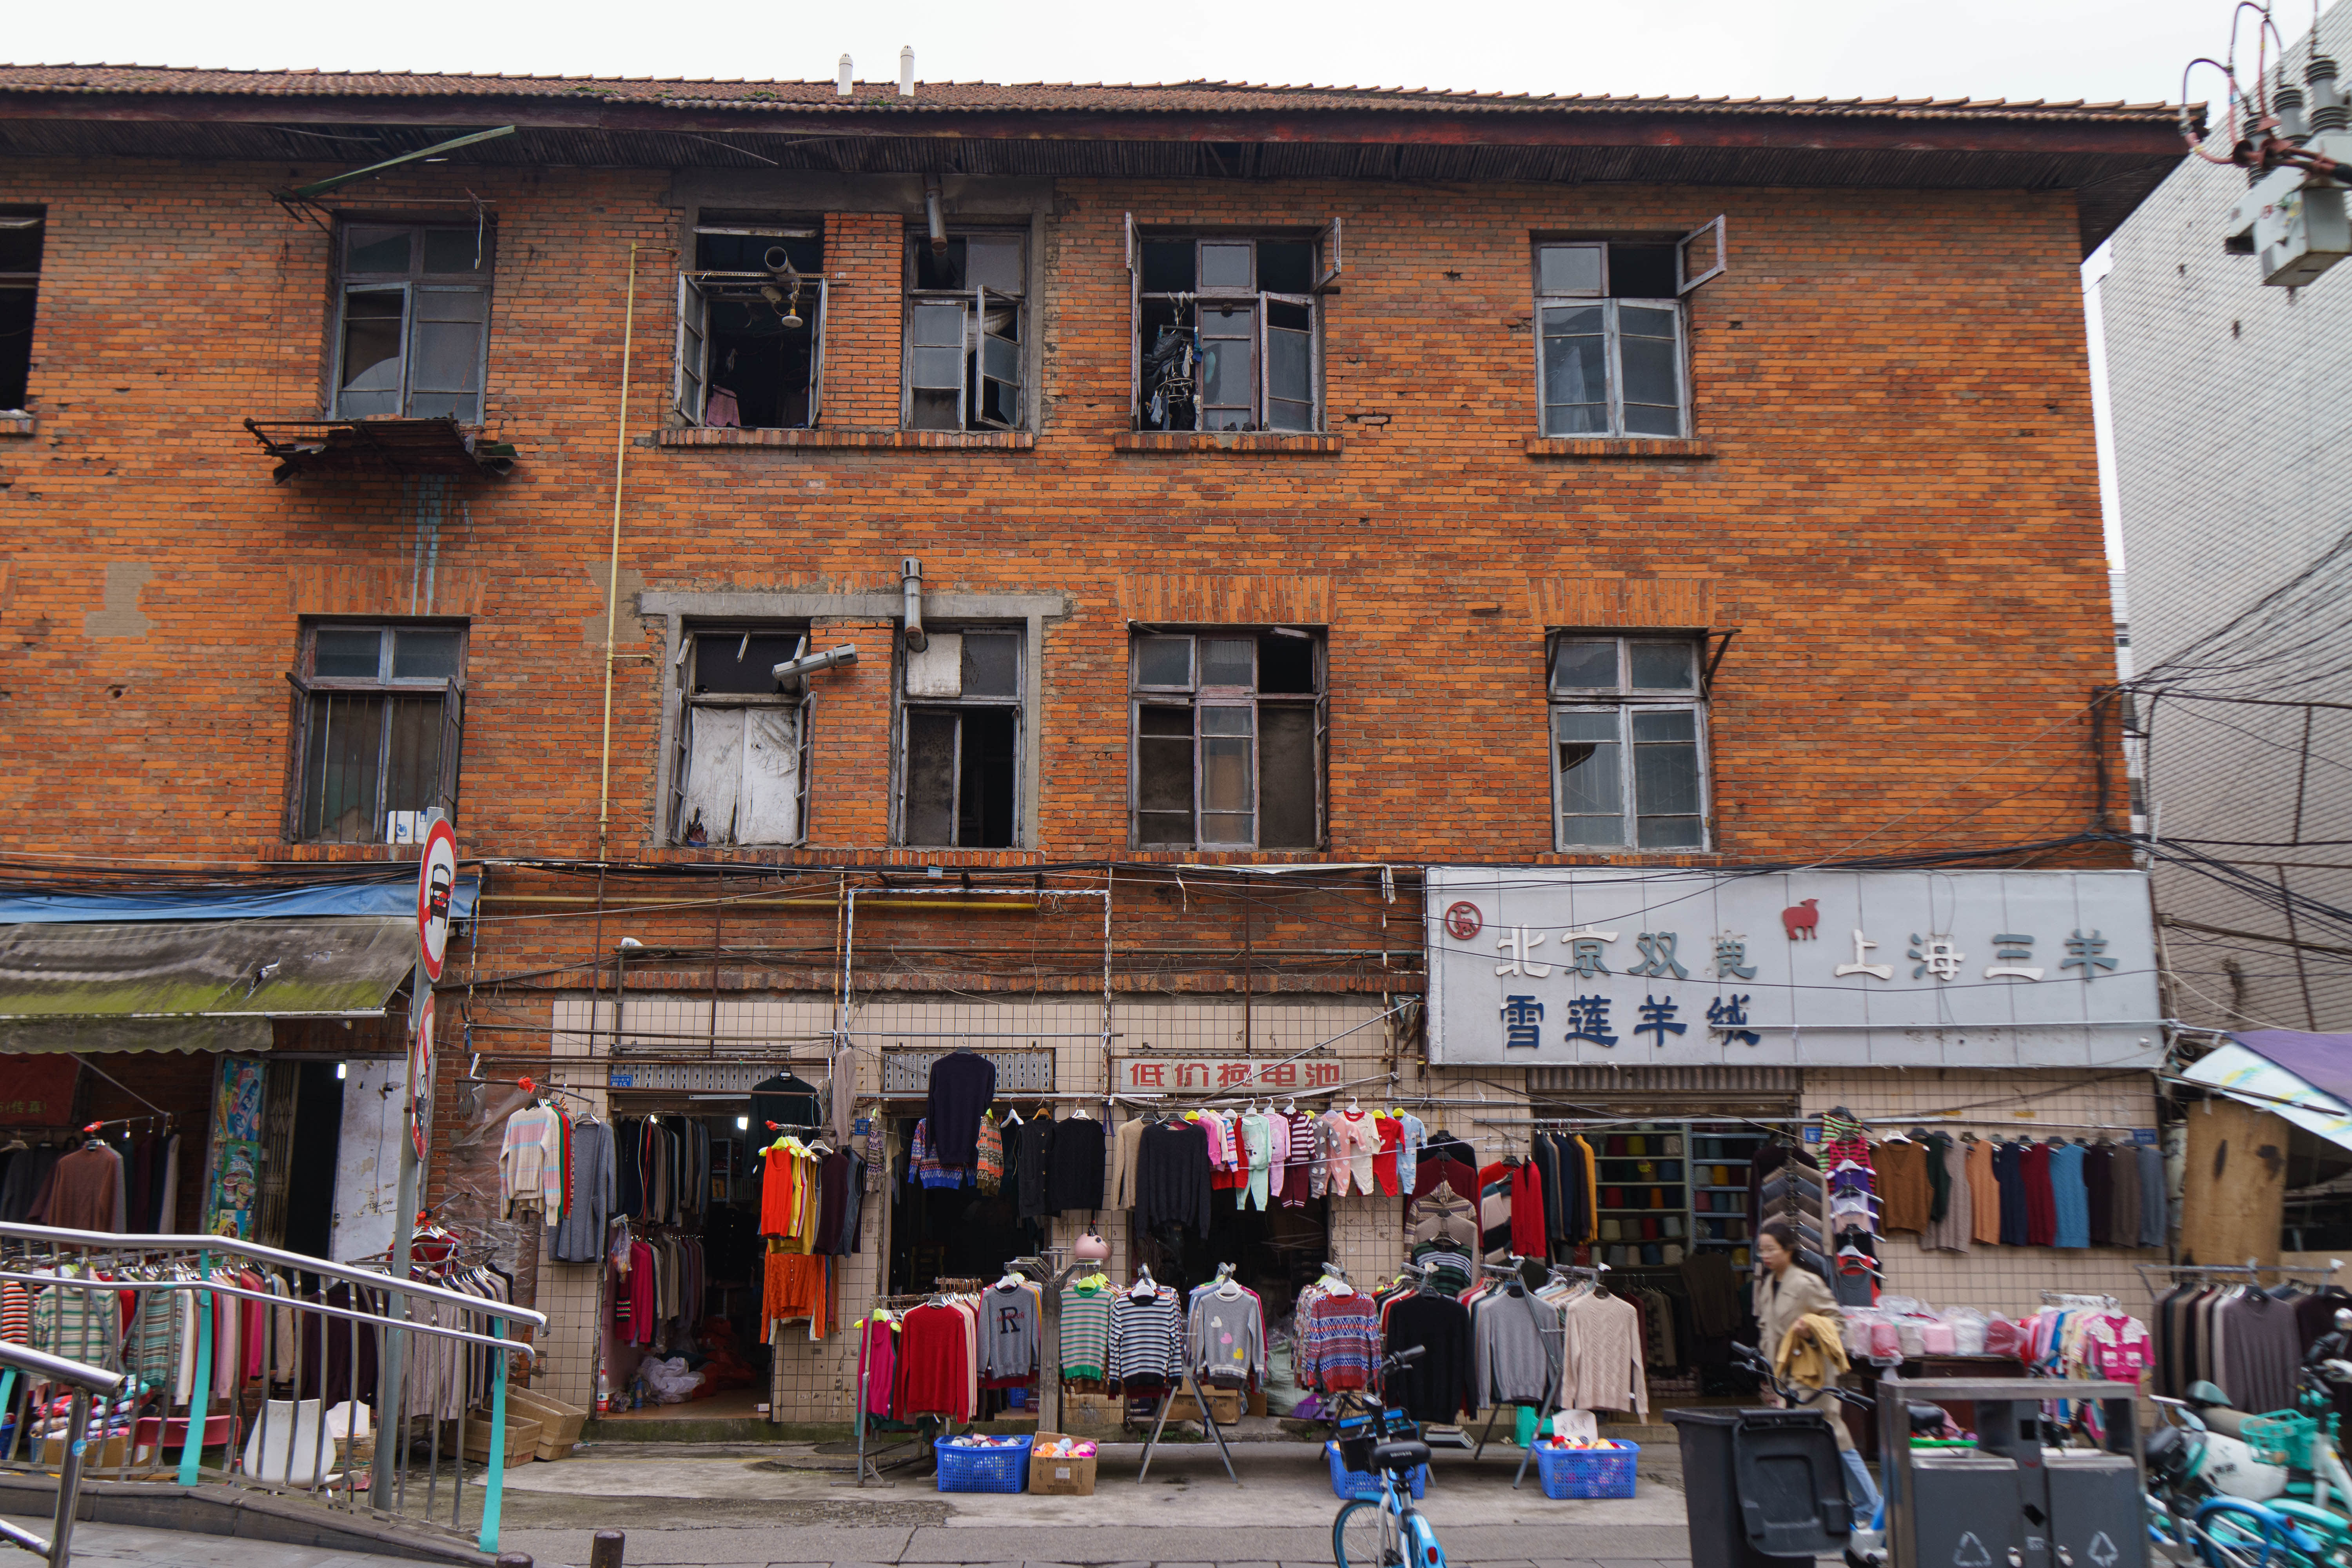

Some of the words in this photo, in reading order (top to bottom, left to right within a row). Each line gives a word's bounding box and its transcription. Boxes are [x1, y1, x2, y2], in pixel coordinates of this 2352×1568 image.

[1835, 929, 2119, 982] 上海三羊
[1500, 994, 1760, 1049] 雪莲羊绒
[1130, 1063, 1339, 1087] 低价换电池
